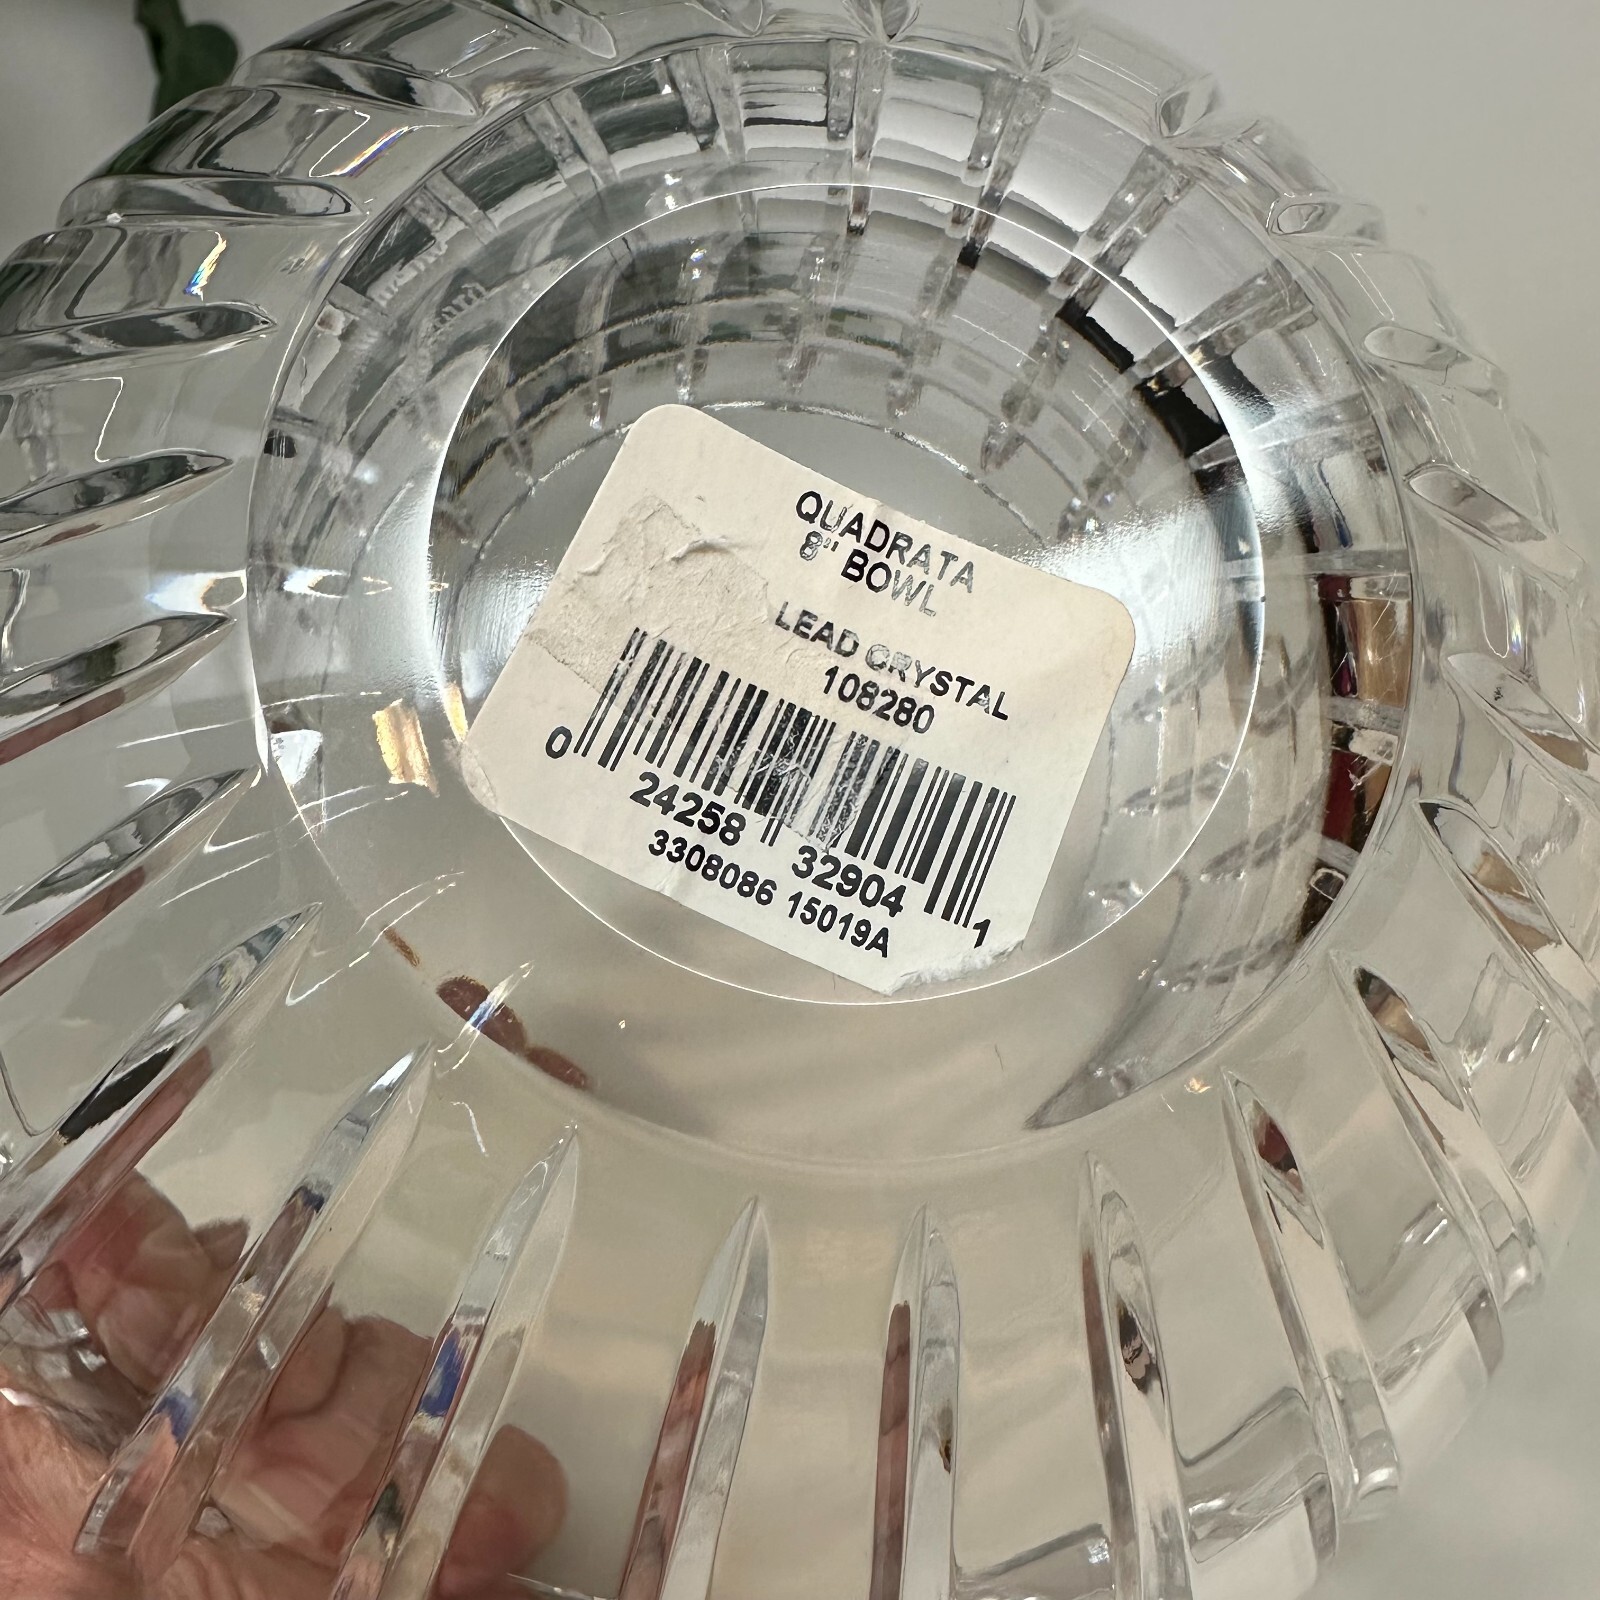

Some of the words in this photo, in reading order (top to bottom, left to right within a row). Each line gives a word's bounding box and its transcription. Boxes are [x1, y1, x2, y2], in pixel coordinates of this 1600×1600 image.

[796, 490, 975, 593] QUADRATA
[799, 531, 840, 561] 8"
[841, 549, 936, 617] BOWL
[775, 602, 859, 657] LEAD
[865, 644, 1008, 720] CRYSTAL
[823, 665, 935, 733] 108280
[545, 726, 573, 759] 0
[630, 771, 746, 846] 24258
[791, 845, 906, 917] 32904
[972, 918, 991, 948] 1
[648, 829, 778, 906] 3308086
[787, 891, 890, 958] 15019A
